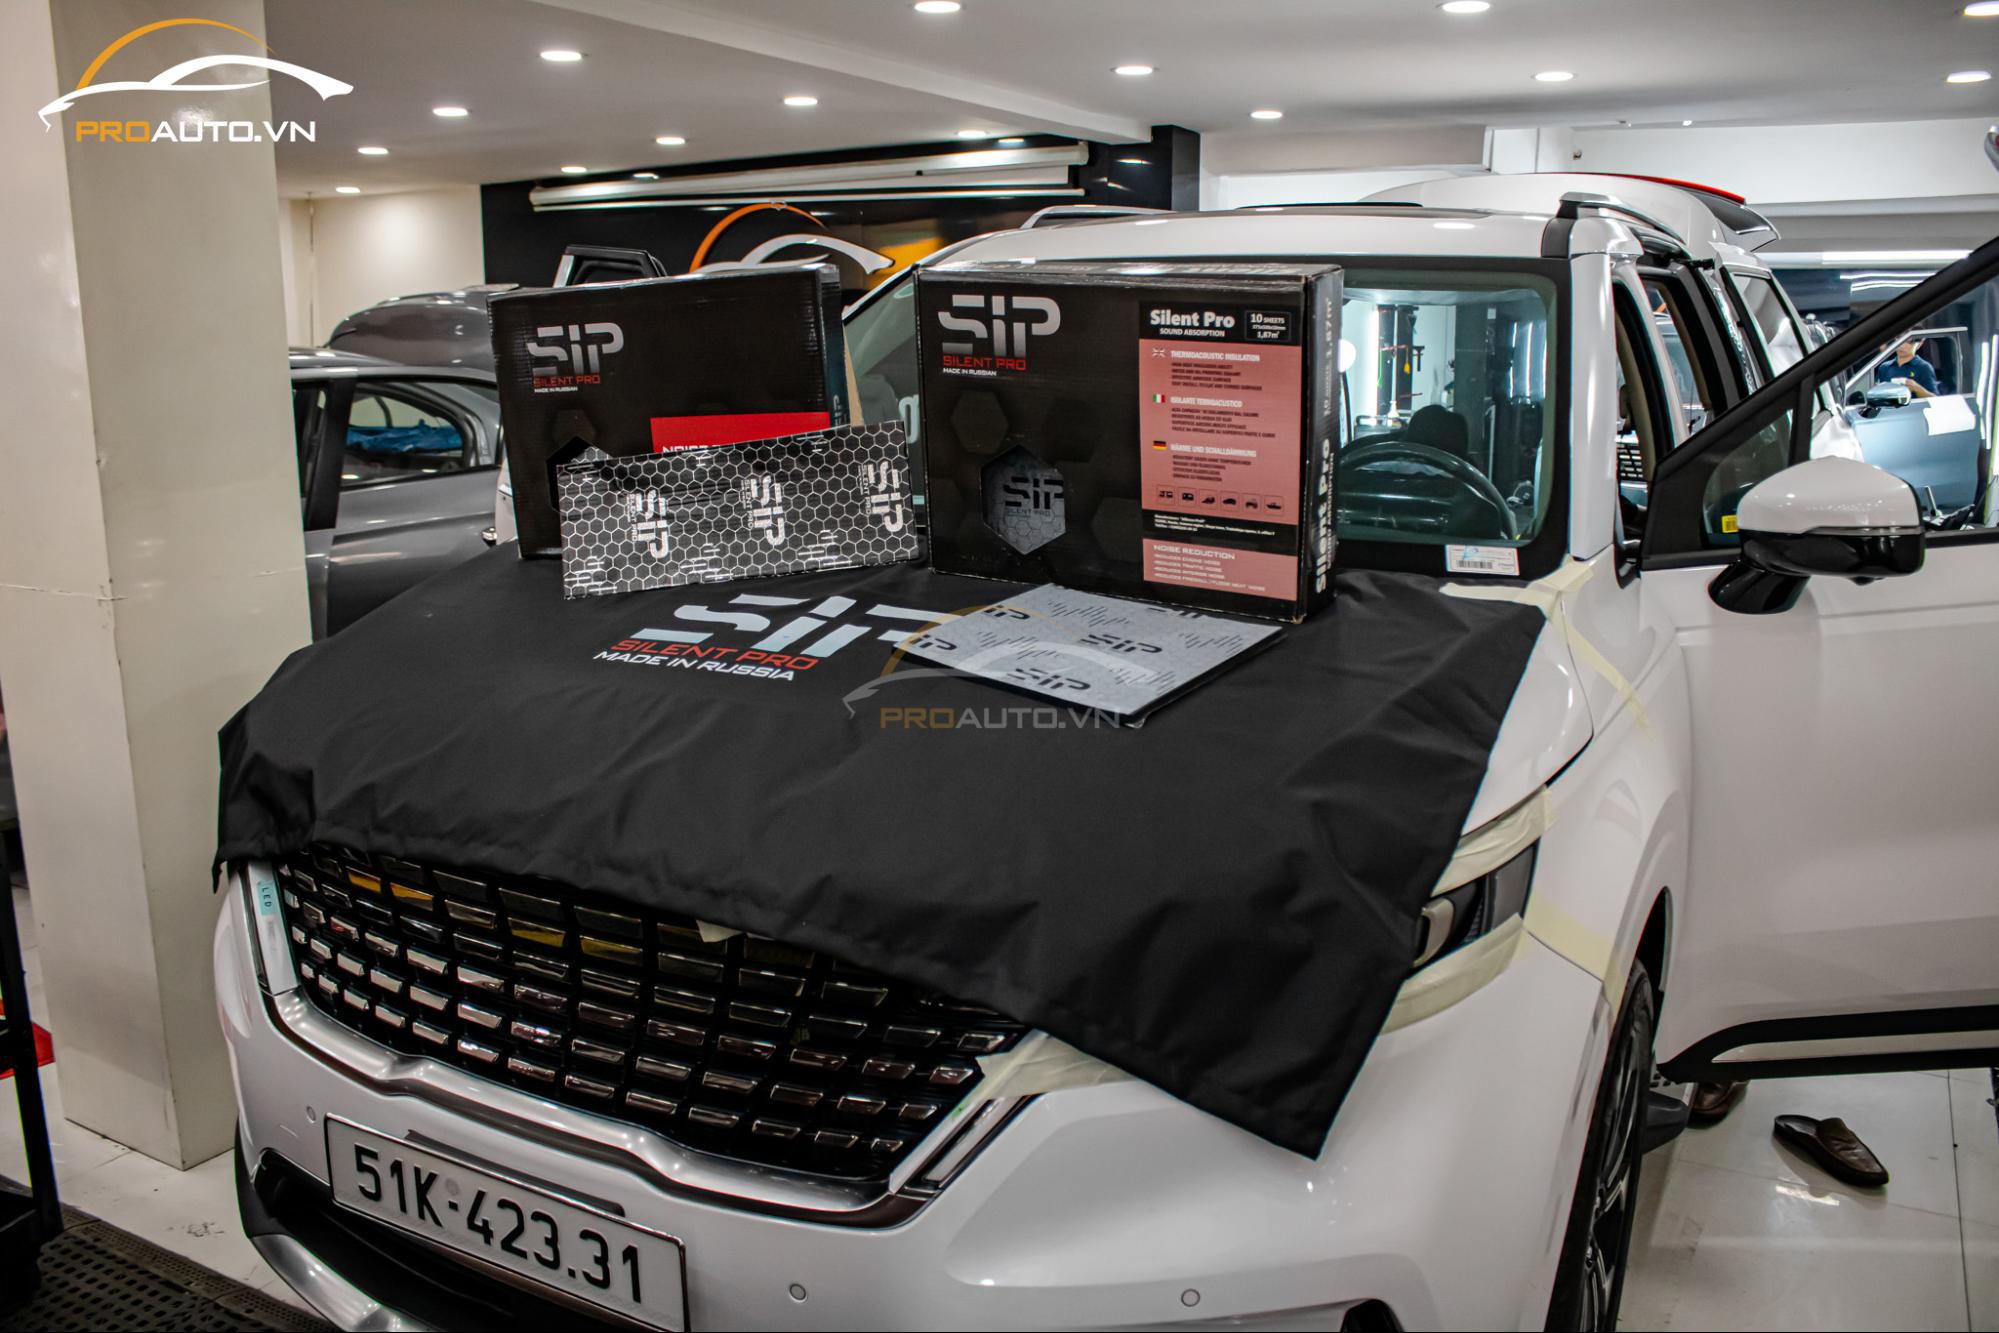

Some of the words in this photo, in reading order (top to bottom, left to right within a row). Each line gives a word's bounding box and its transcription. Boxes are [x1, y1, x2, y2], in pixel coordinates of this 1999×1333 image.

[1150, 309, 1199, 326] Silent
[1203, 311, 1235, 328] Pro
[1250, 313, 1263, 323] 10
[1184, 329, 1225, 337] ABSORPTION
[943, 355, 993, 369] SILENT
[995, 357, 1027, 371] PRO
[533, 376, 573, 388] SILENT
[576, 374, 601, 384] PRO
[1319, 438, 1330, 496] Pro
[1153, 545, 1181, 554] NOISE
[1182, 547, 1235, 560] REDUCTION
[611, 639, 732, 660] SILENT
[735, 651, 823, 671] PRO
[592, 651, 662, 666] MADE
[669, 659, 697, 670] IN
[697, 661, 796, 682] RUSSIA
[262, 887, 272, 908] LED
[353, 1143, 642, 1305] 51K-423.31
